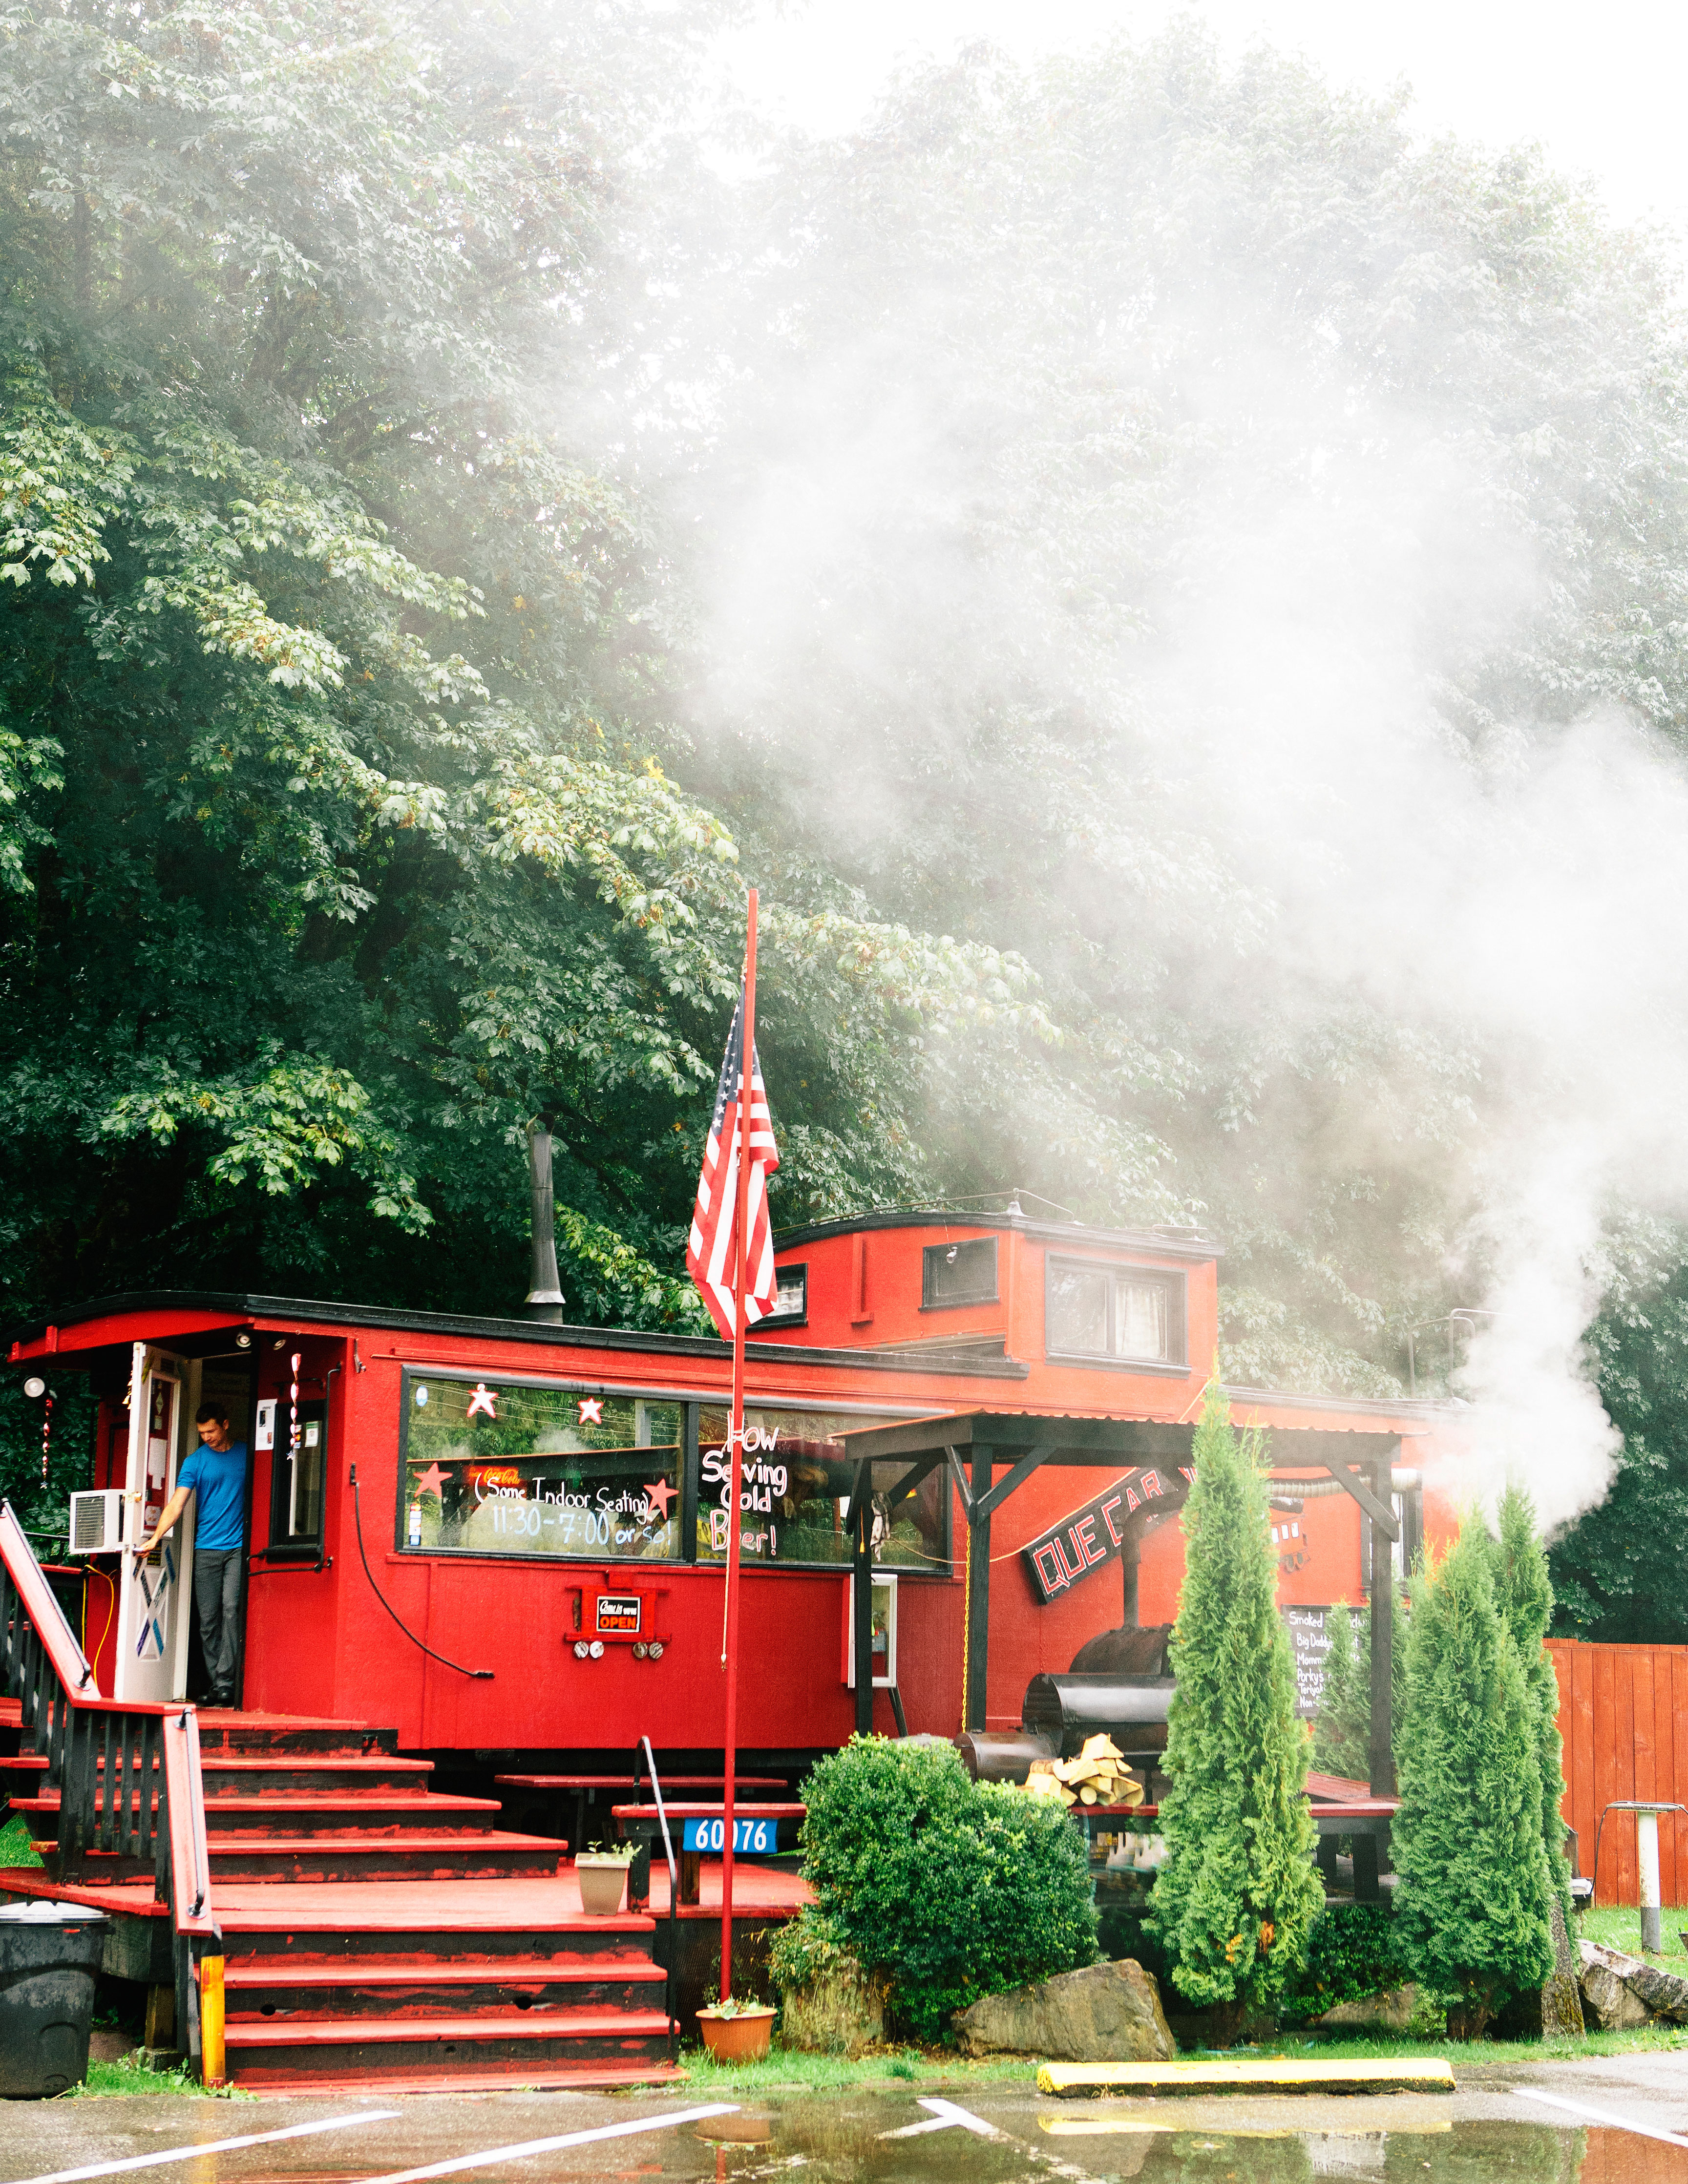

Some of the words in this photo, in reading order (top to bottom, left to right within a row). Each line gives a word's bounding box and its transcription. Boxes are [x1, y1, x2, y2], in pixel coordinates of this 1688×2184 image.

[702, 1450, 787, 1496] Seving
[531, 1476, 591, 1508] Indoor
[614, 1528, 636, 1545] or
[710, 1508, 777, 1556] Ber!
[599, 1616, 636, 1629] OPEN
[1288, 1611, 1323, 1628] Smoked
[1296, 1632, 1309, 1650] Big
